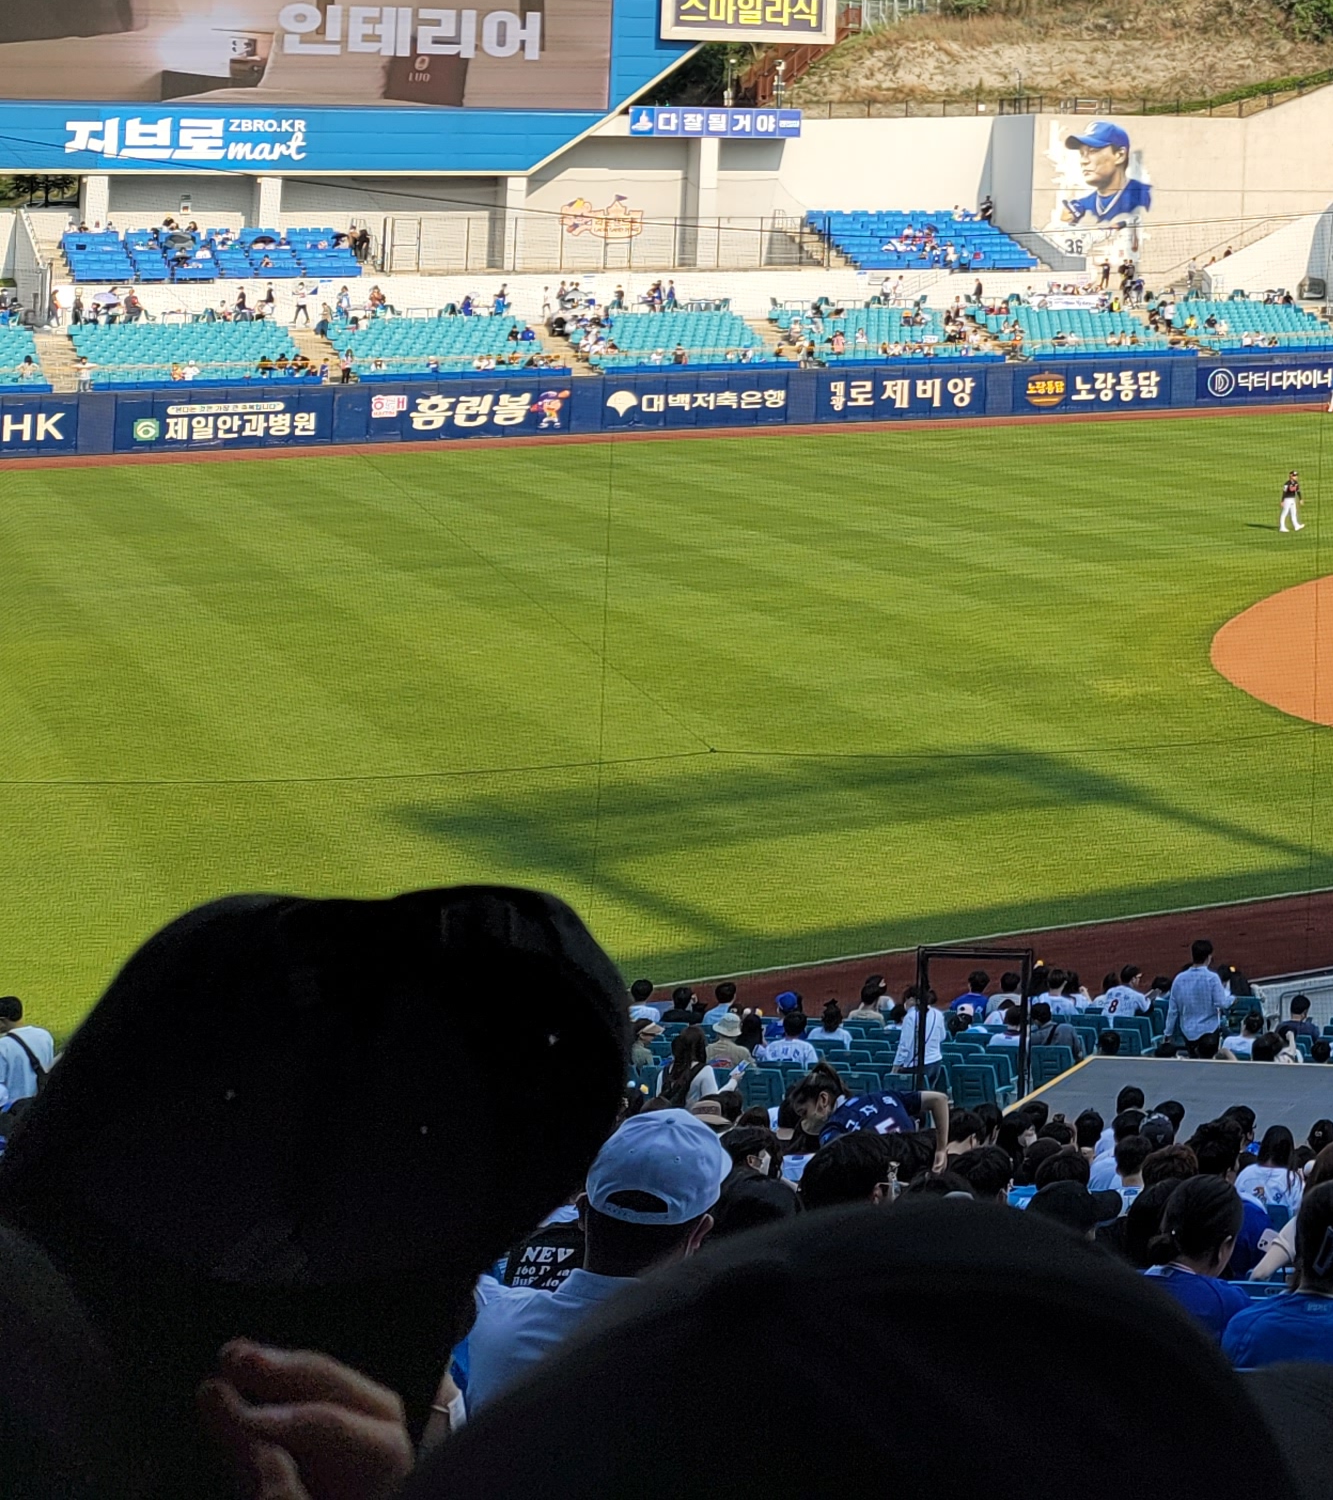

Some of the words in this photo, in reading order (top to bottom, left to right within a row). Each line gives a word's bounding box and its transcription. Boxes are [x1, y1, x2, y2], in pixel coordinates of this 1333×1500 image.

[278, 3, 541, 60] 인테리어
[64, 117, 226, 160] 지브로
[228, 119, 306, 132] ZBRO.KR
[227, 132, 307, 161] mart
[1065, 238, 1083, 254] 36
[1071, 371, 1161, 401] 노랑통닭
[1237, 371, 1270, 391] 닥터
[1271, 368, 1333, 390] 디자이너
[410, 393, 532, 431] 홈런볼
[641, 389, 786, 412] 대백저축은행
[2, 412, 65, 442] HK
[165, 412, 317, 440] 제일안과병원
[1108, 999, 1119, 1014] 8
